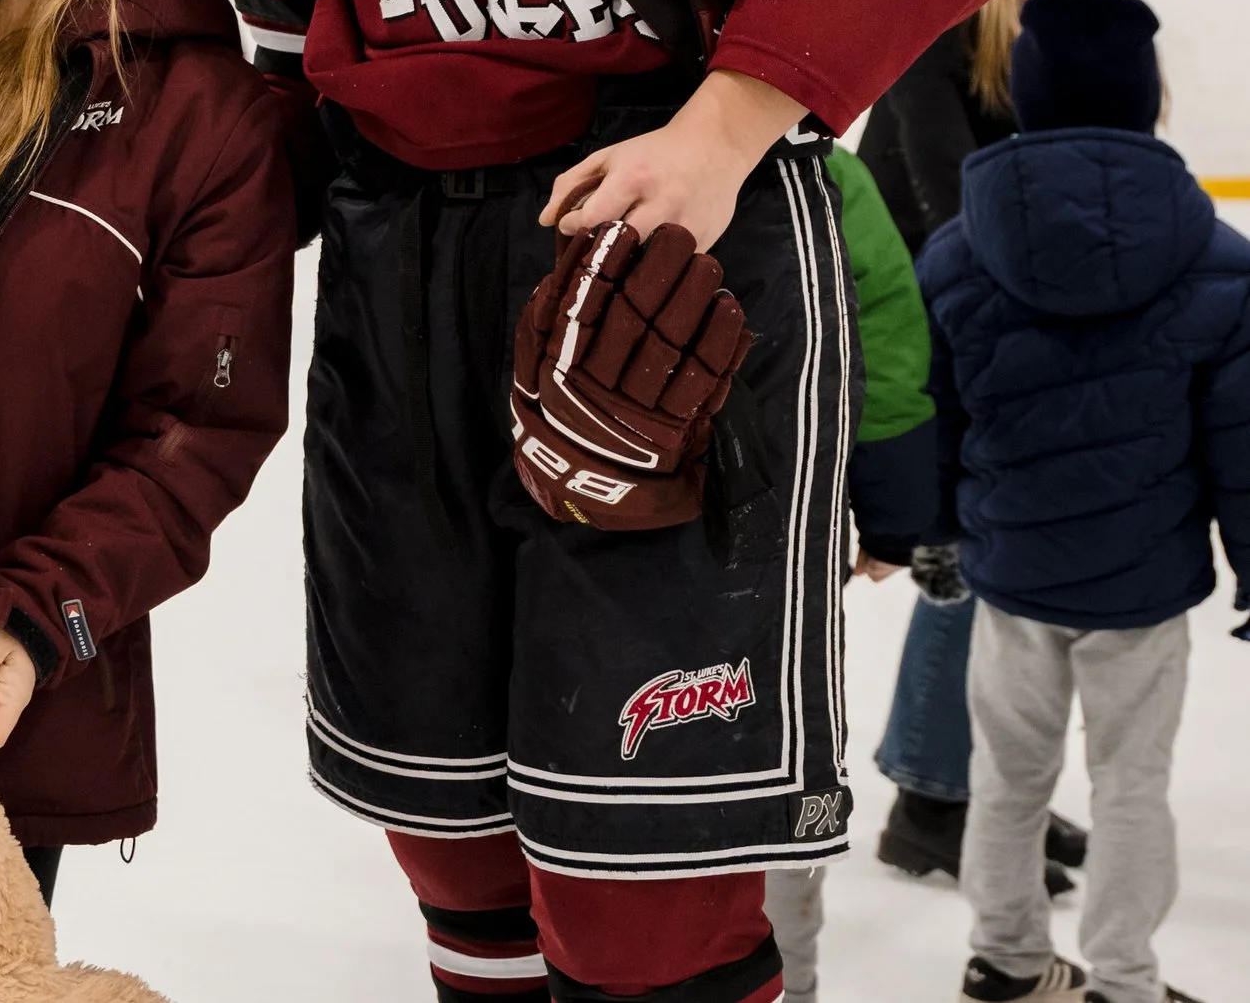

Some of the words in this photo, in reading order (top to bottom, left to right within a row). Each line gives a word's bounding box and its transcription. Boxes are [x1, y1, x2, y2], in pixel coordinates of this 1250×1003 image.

[683, 670, 697, 681] ST.
[697, 663, 725, 679] LUKE'S
[618, 657, 756, 761] STORM
[794, 791, 843, 838] PX
